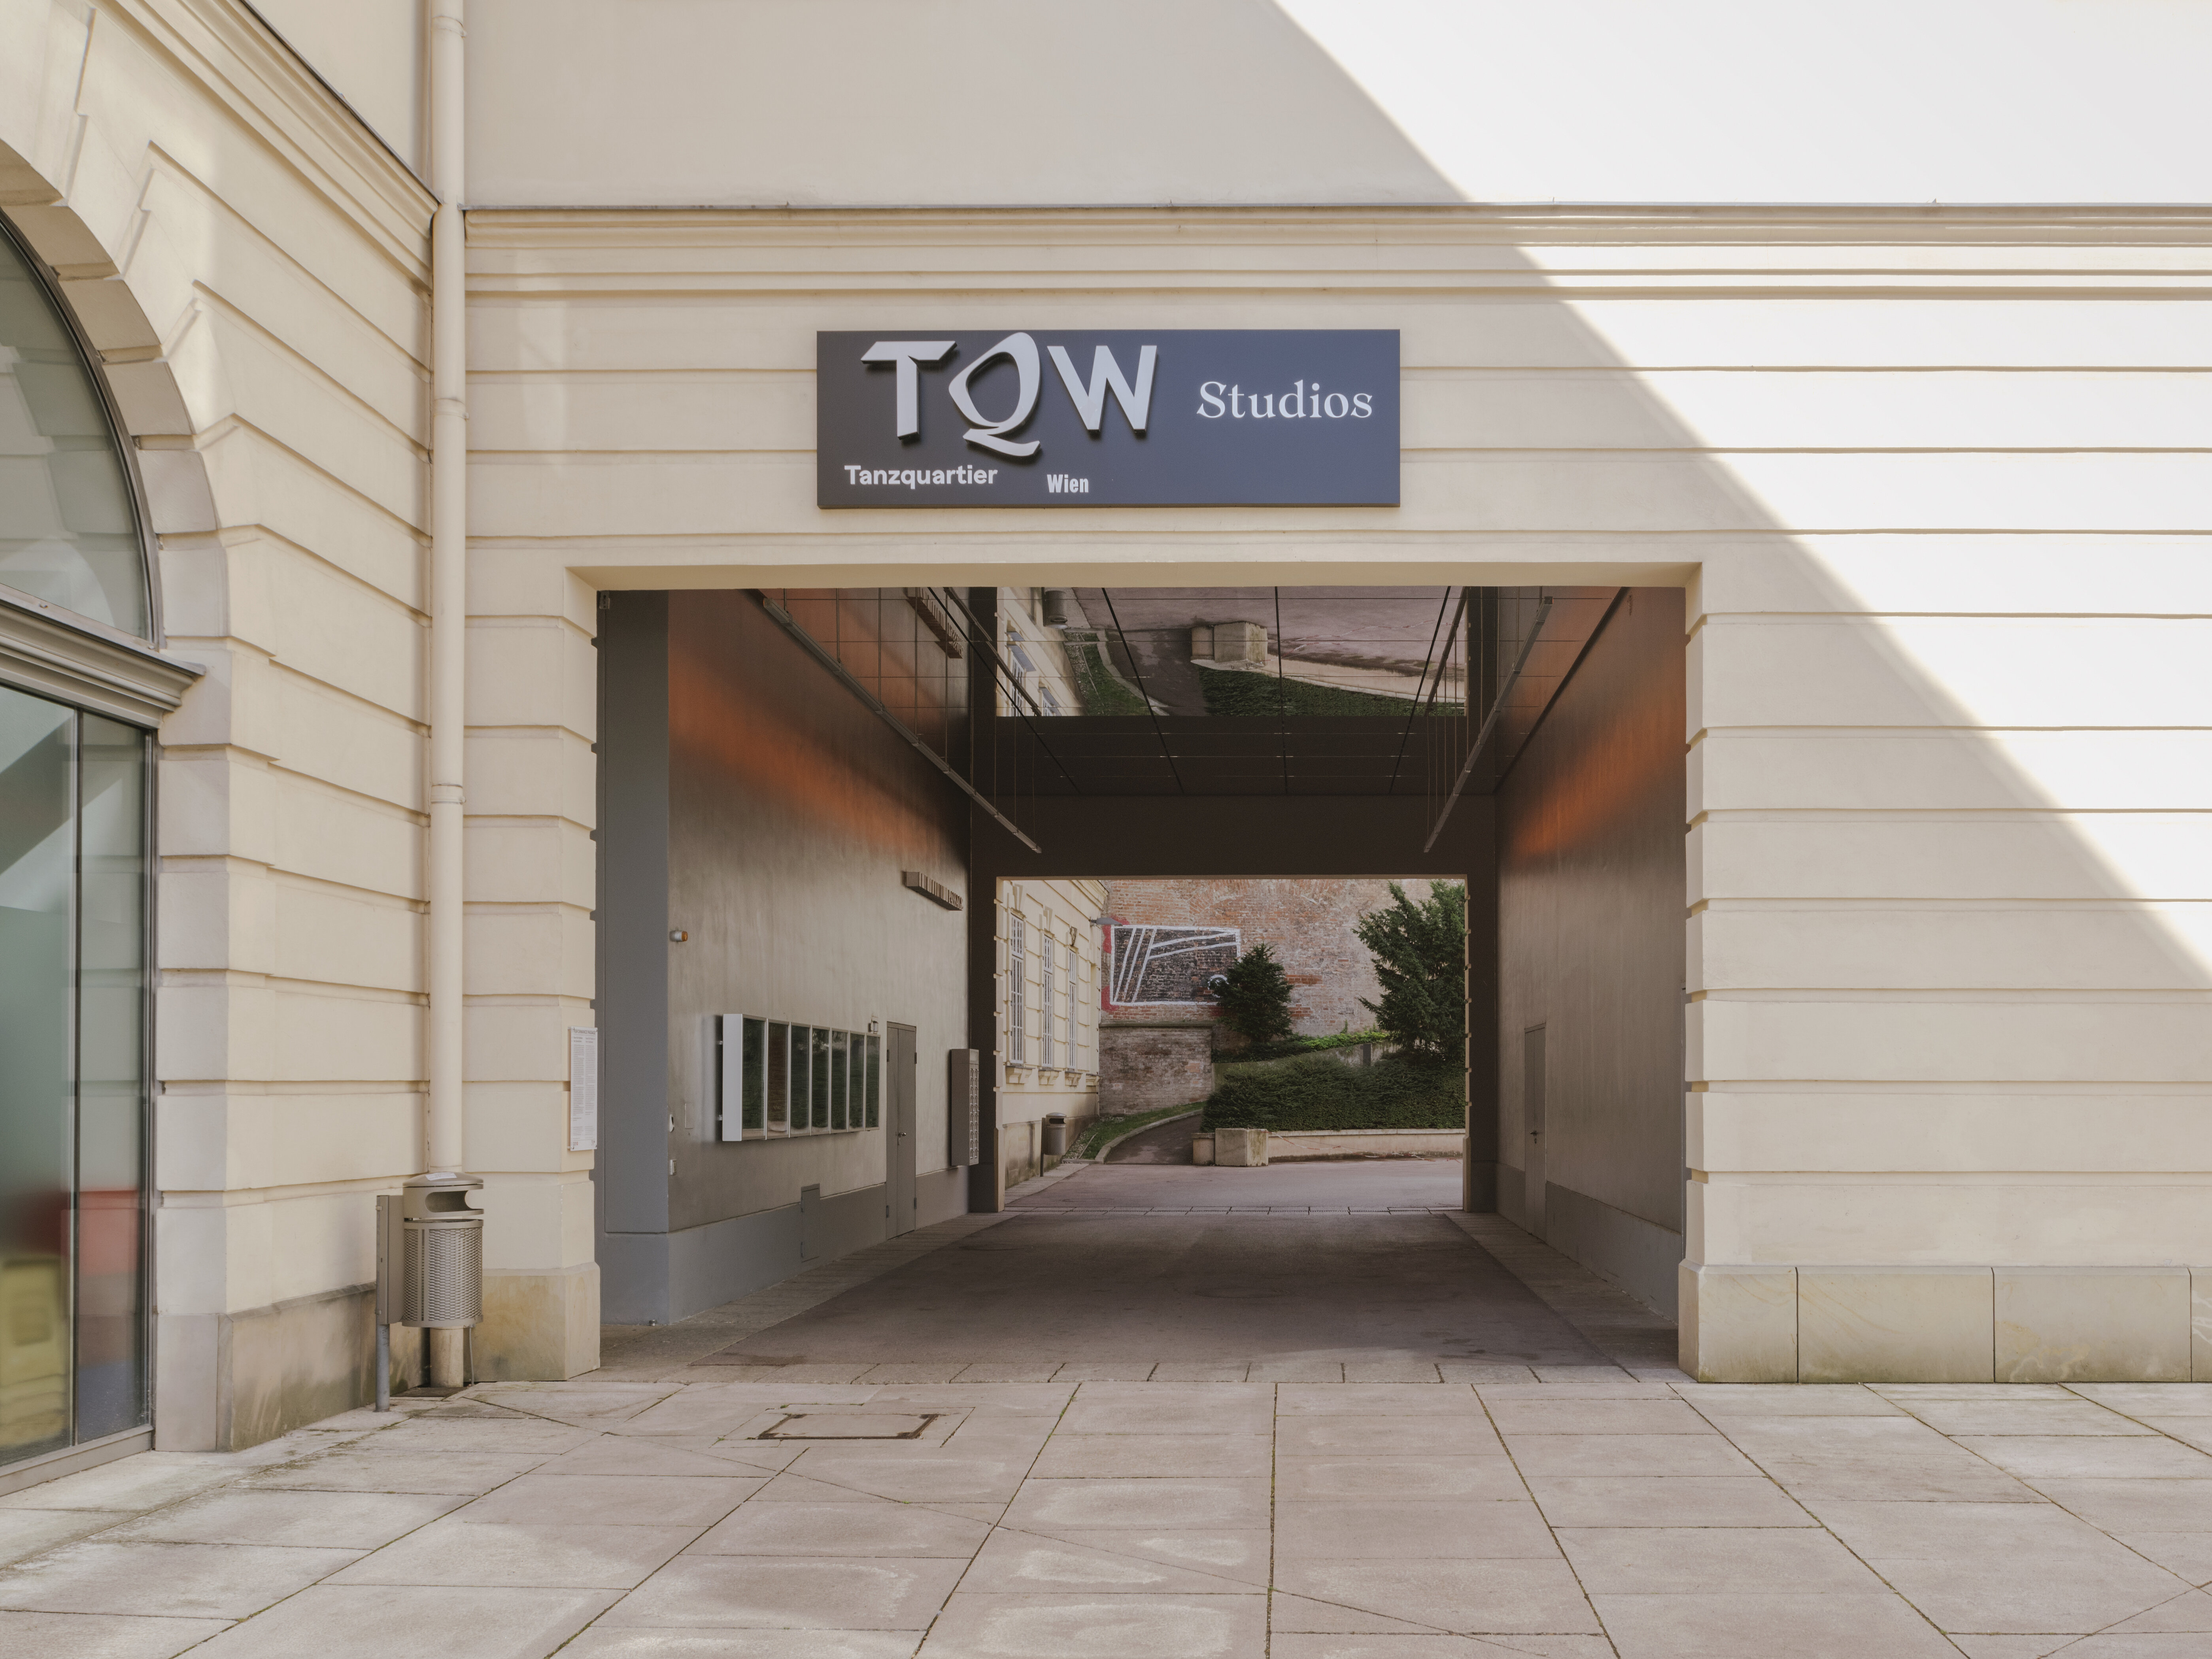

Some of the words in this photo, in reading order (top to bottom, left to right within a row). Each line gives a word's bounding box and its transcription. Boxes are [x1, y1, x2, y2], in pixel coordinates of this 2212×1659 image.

[860, 332, 1158, 457] TQW
[1196, 379, 1373, 418] Studios
[844, 464, 998, 490] Tanzquartier
[1046, 474, 1089, 493] Wien
